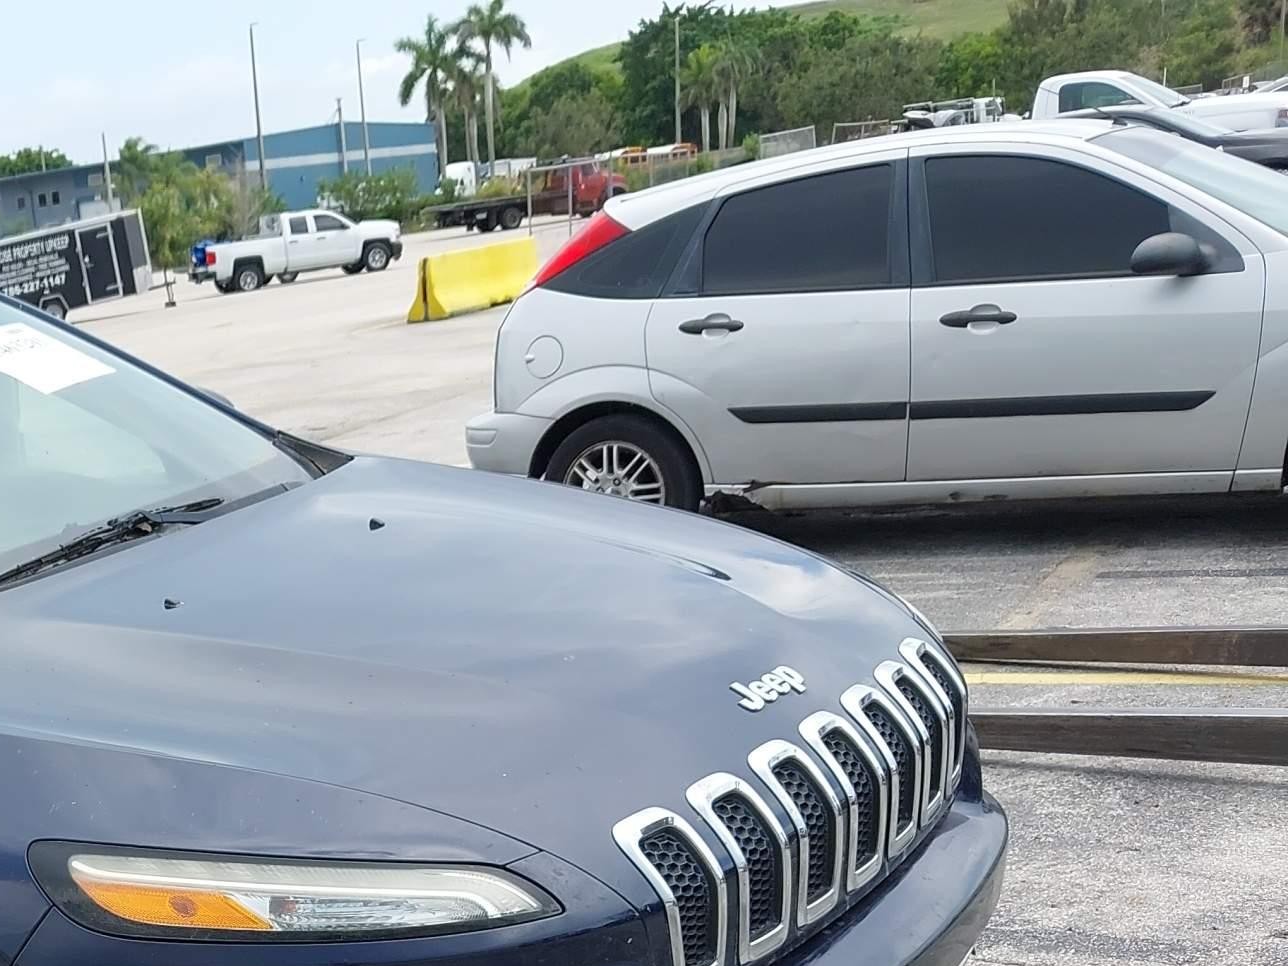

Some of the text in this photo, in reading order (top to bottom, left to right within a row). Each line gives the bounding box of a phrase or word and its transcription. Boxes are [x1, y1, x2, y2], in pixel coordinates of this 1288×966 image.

[13, 239, 45, 260] PROPERTY
[44, 233, 69, 253] UPKEEP
[729, 665, 807, 713] Jeep
